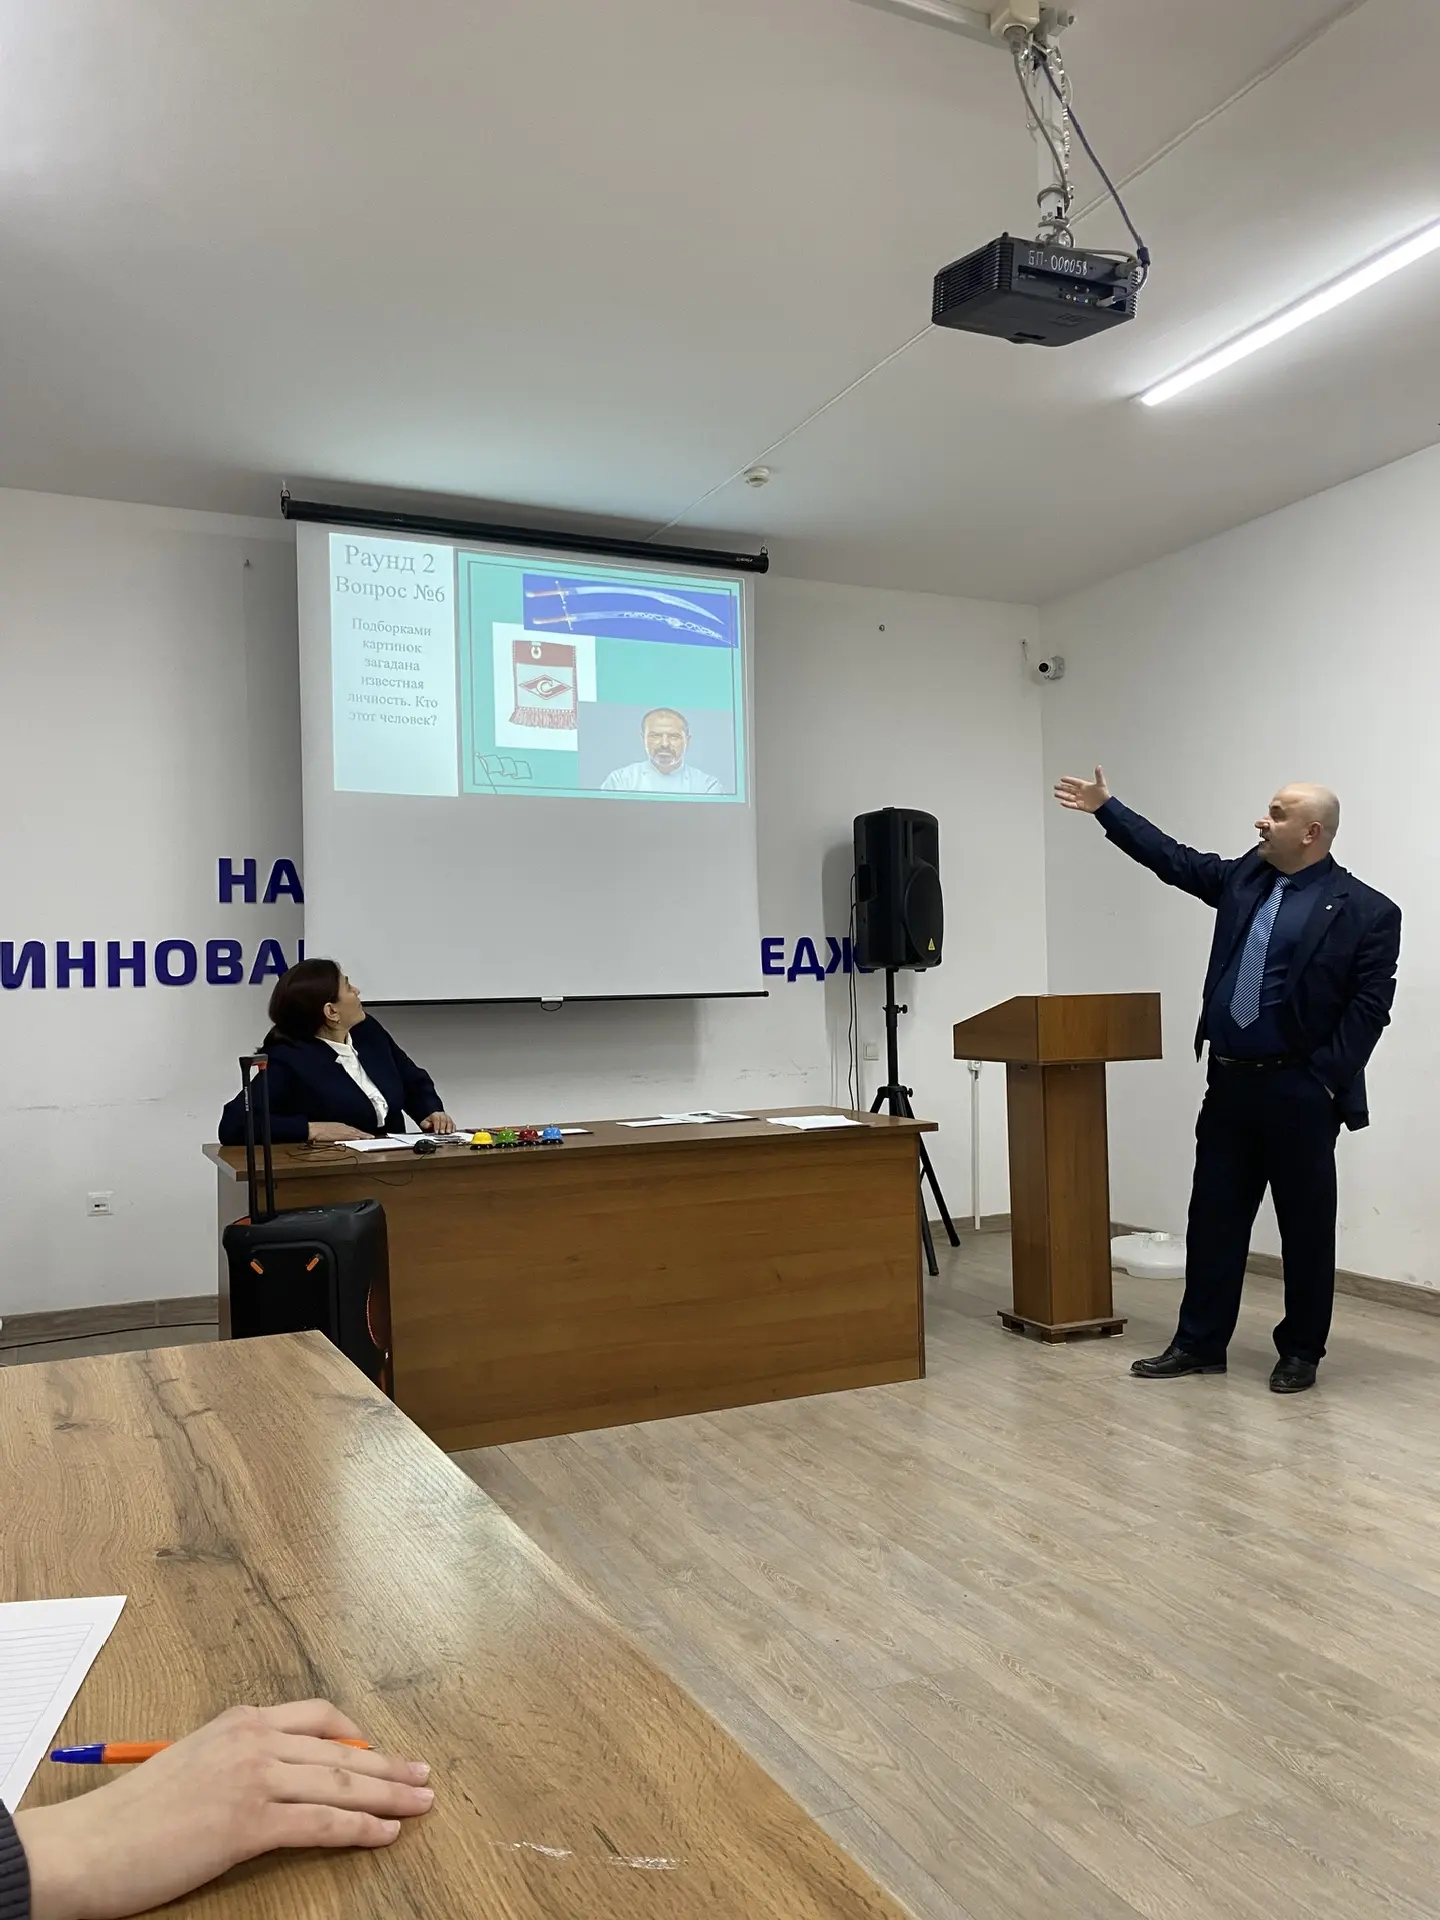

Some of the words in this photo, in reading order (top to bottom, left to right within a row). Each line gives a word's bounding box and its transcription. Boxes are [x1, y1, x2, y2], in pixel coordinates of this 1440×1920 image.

[345, 545, 415, 574] Раунд
[422, 554, 435, 573] 2
[335, 575, 407, 601] Вопрос
[413, 584, 445, 602] №6
[351, 617, 431, 636] Подборками
[362, 640, 422, 653] картинок
[364, 657, 420, 671] загадана
[361, 675, 424, 690] известная
[347, 693, 411, 707] личность.
[415, 697, 438, 708] Кто
[348, 711, 376, 723] этот
[380, 713, 437, 726] человек?
[218, 857, 304, 903] НА
[0, 939, 305, 989] ИННОВА
